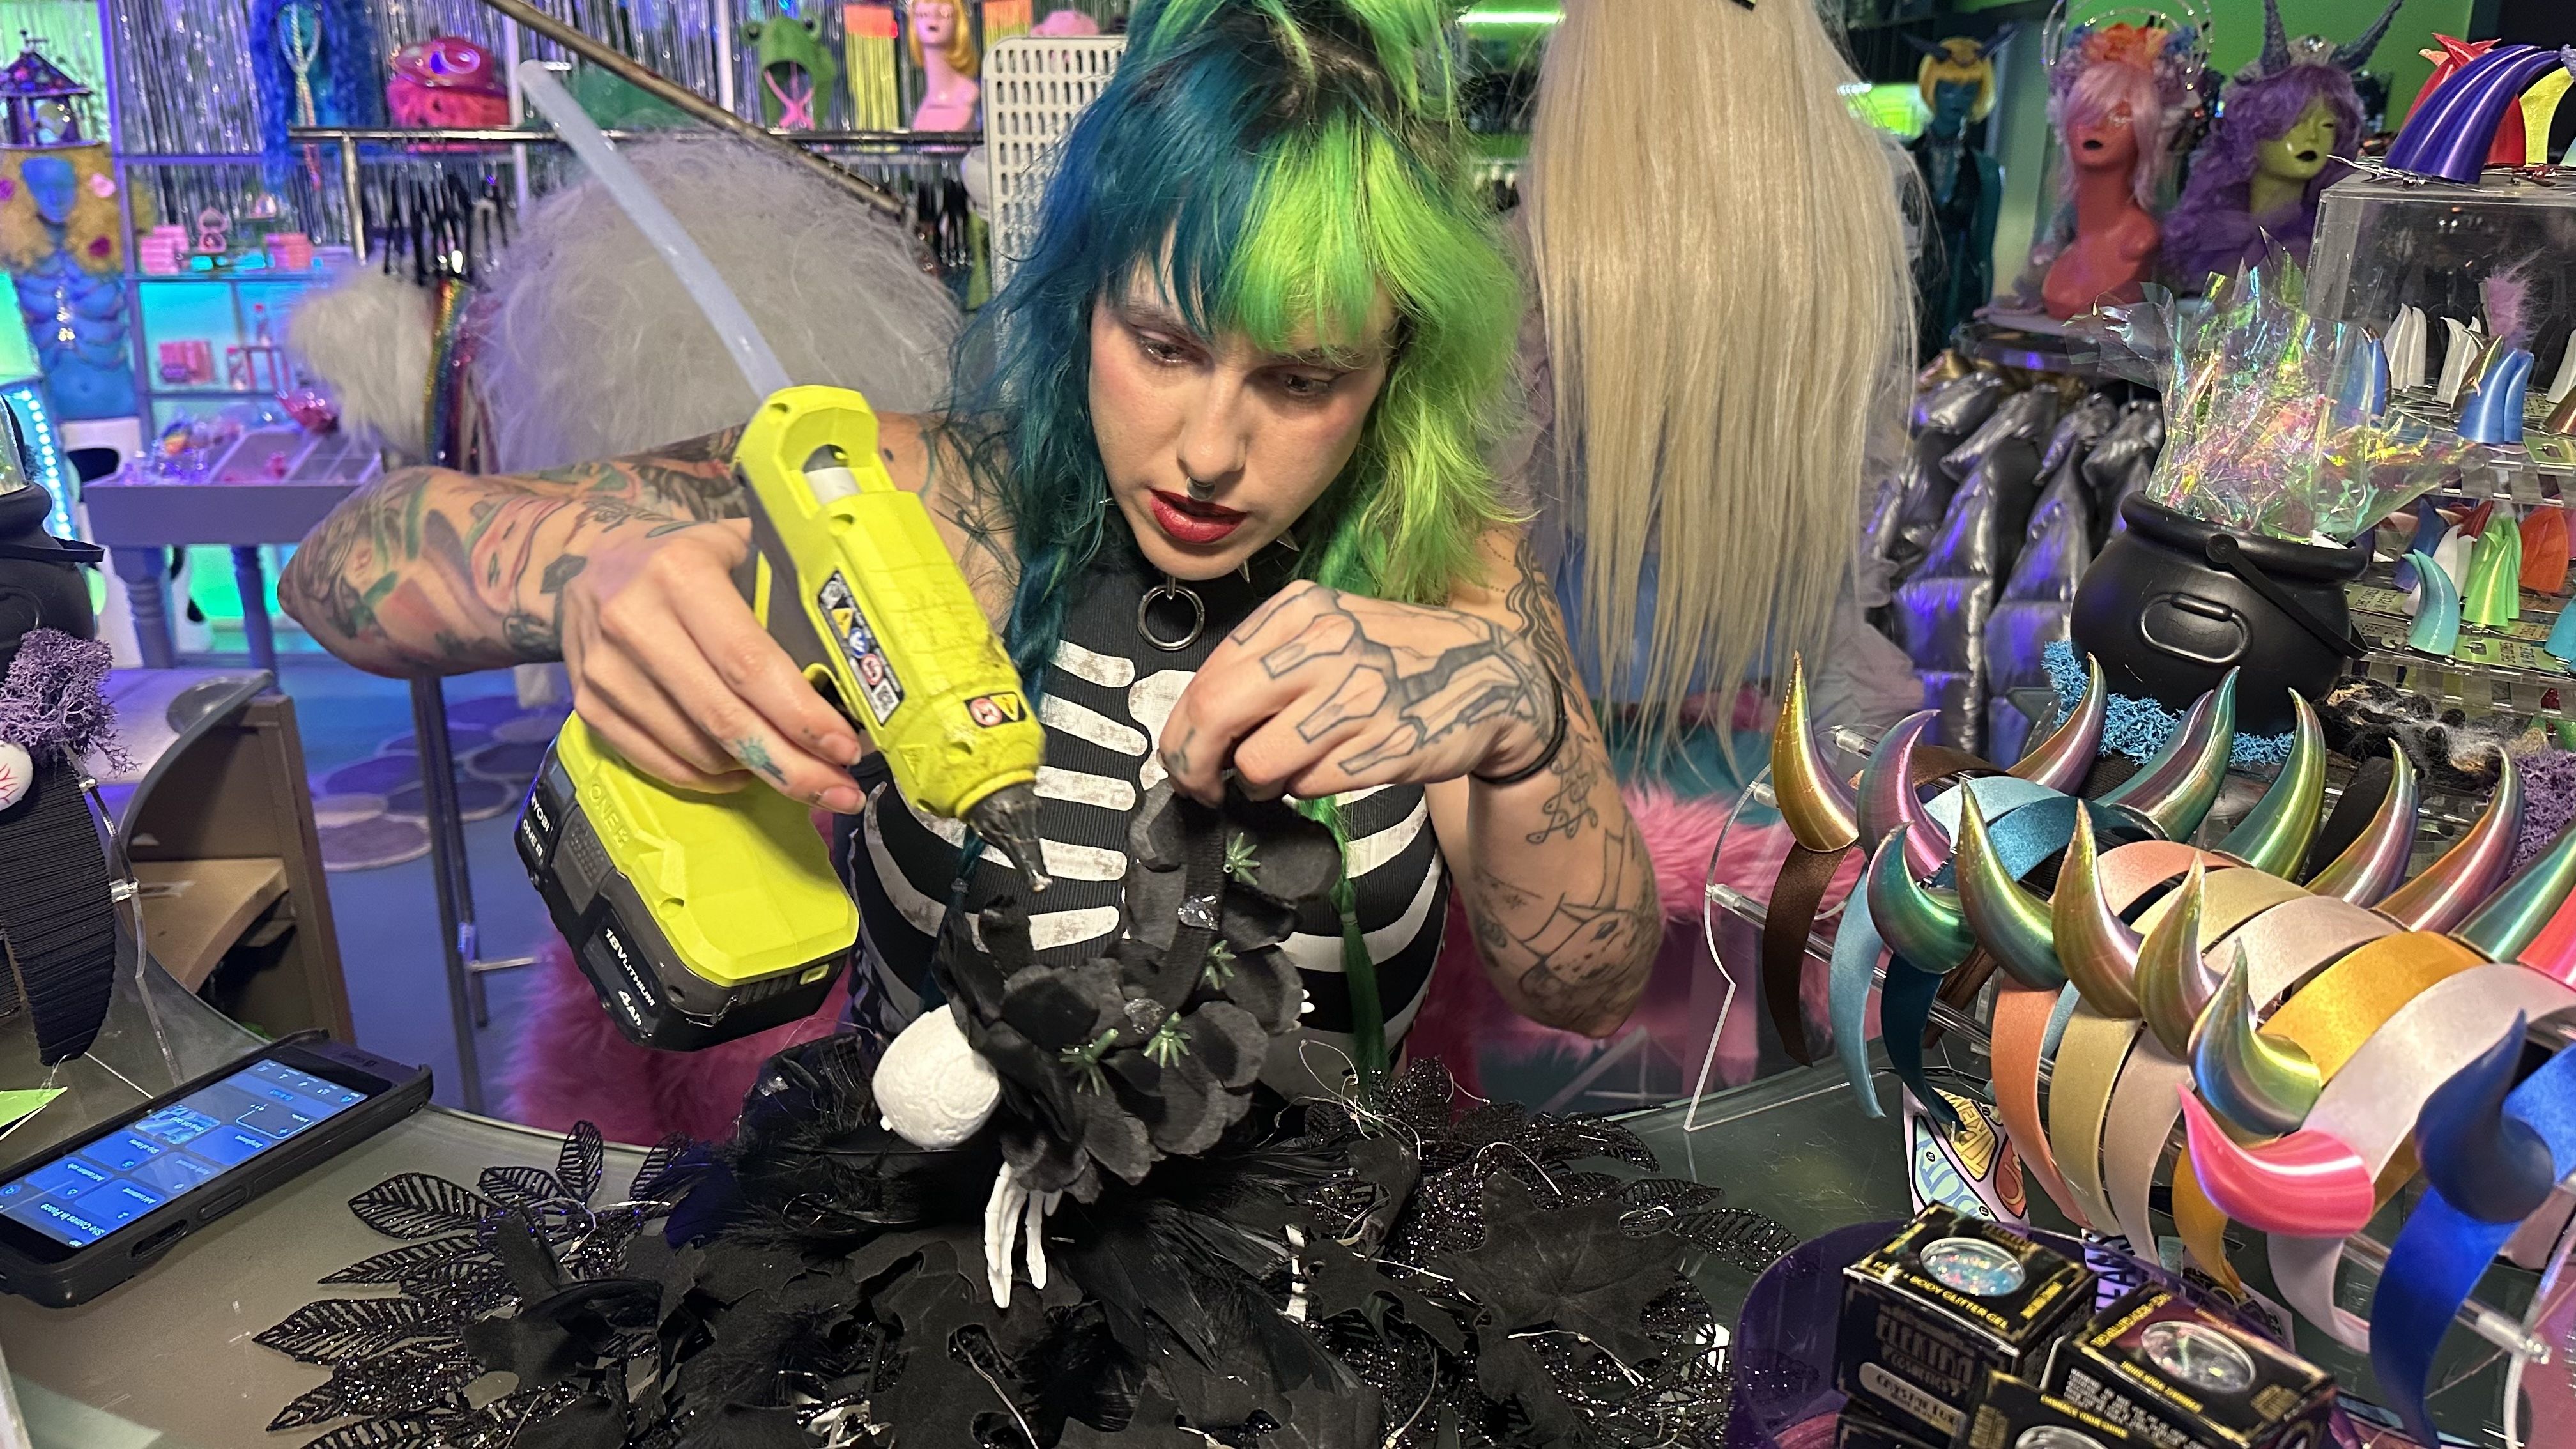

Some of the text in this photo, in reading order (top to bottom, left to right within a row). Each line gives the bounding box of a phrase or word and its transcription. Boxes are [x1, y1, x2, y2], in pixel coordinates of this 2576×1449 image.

[530, 791, 550, 832] RYOBI
[618, 990, 642, 1026] 4Ah
[40, 1202, 63, 1217] Peace
[67, 1215, 92, 1230] Comes
[1909, 1276, 1943, 1294] BODY
[1942, 1291, 1988, 1319] GLITTER
[1986, 1313, 2010, 1330] GEL
